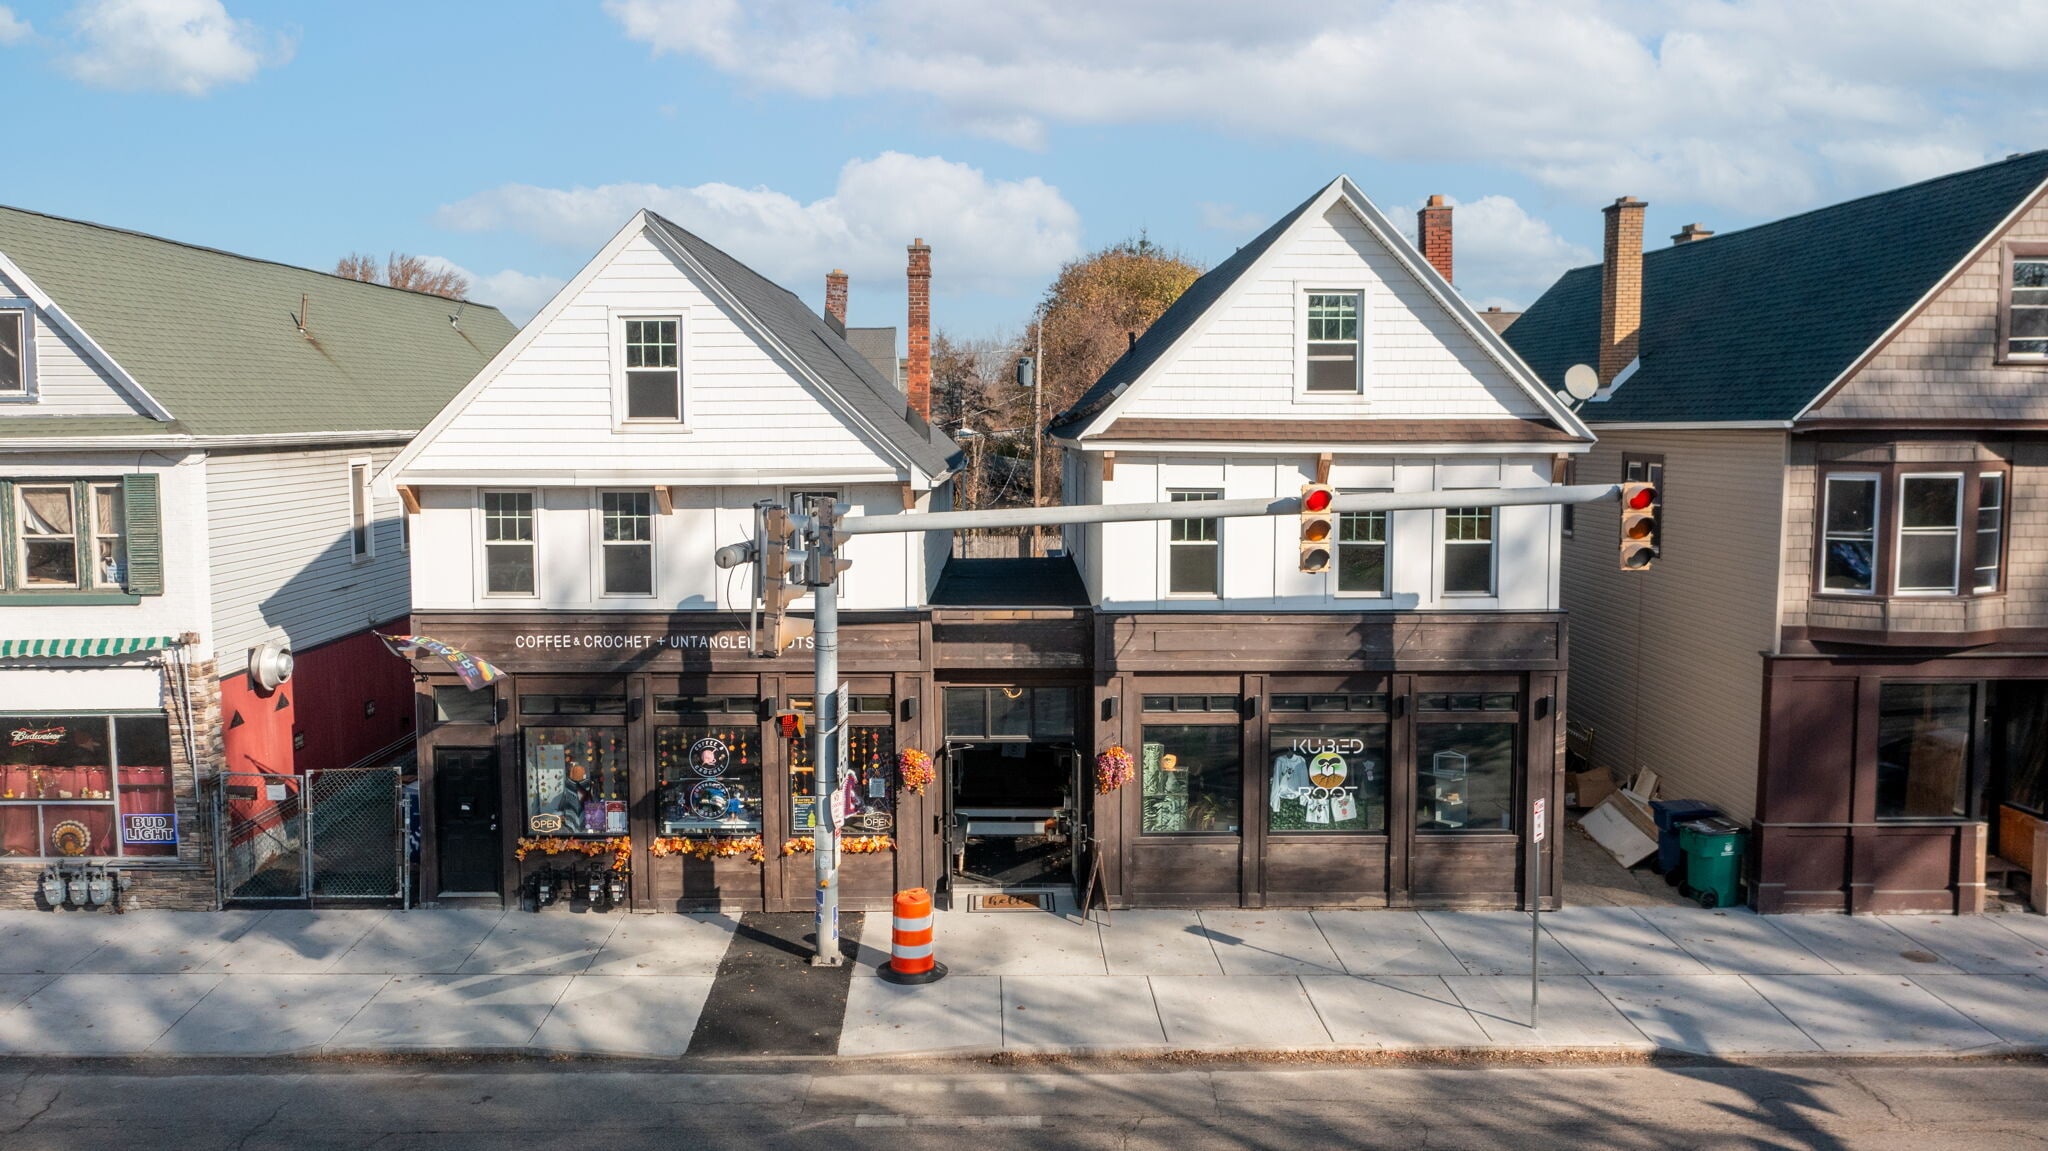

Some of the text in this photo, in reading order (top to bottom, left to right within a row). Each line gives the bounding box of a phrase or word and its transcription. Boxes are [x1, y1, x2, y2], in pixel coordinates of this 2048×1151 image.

[515, 635, 571, 648] COFFEE
[573, 637, 581, 646] &
[583, 635, 652, 648] CROCHET
[670, 635, 751, 648] UNTANGLE
[10, 730, 64, 741] Budweiser
[1293, 739, 1364, 754] KUBED
[1298, 786, 1358, 801] ROOT
[131, 816, 167, 829] BUD
[532, 820, 560, 829] OPEN
[865, 818, 891, 827] OPEN
[126, 828, 174, 840] LIGHT
